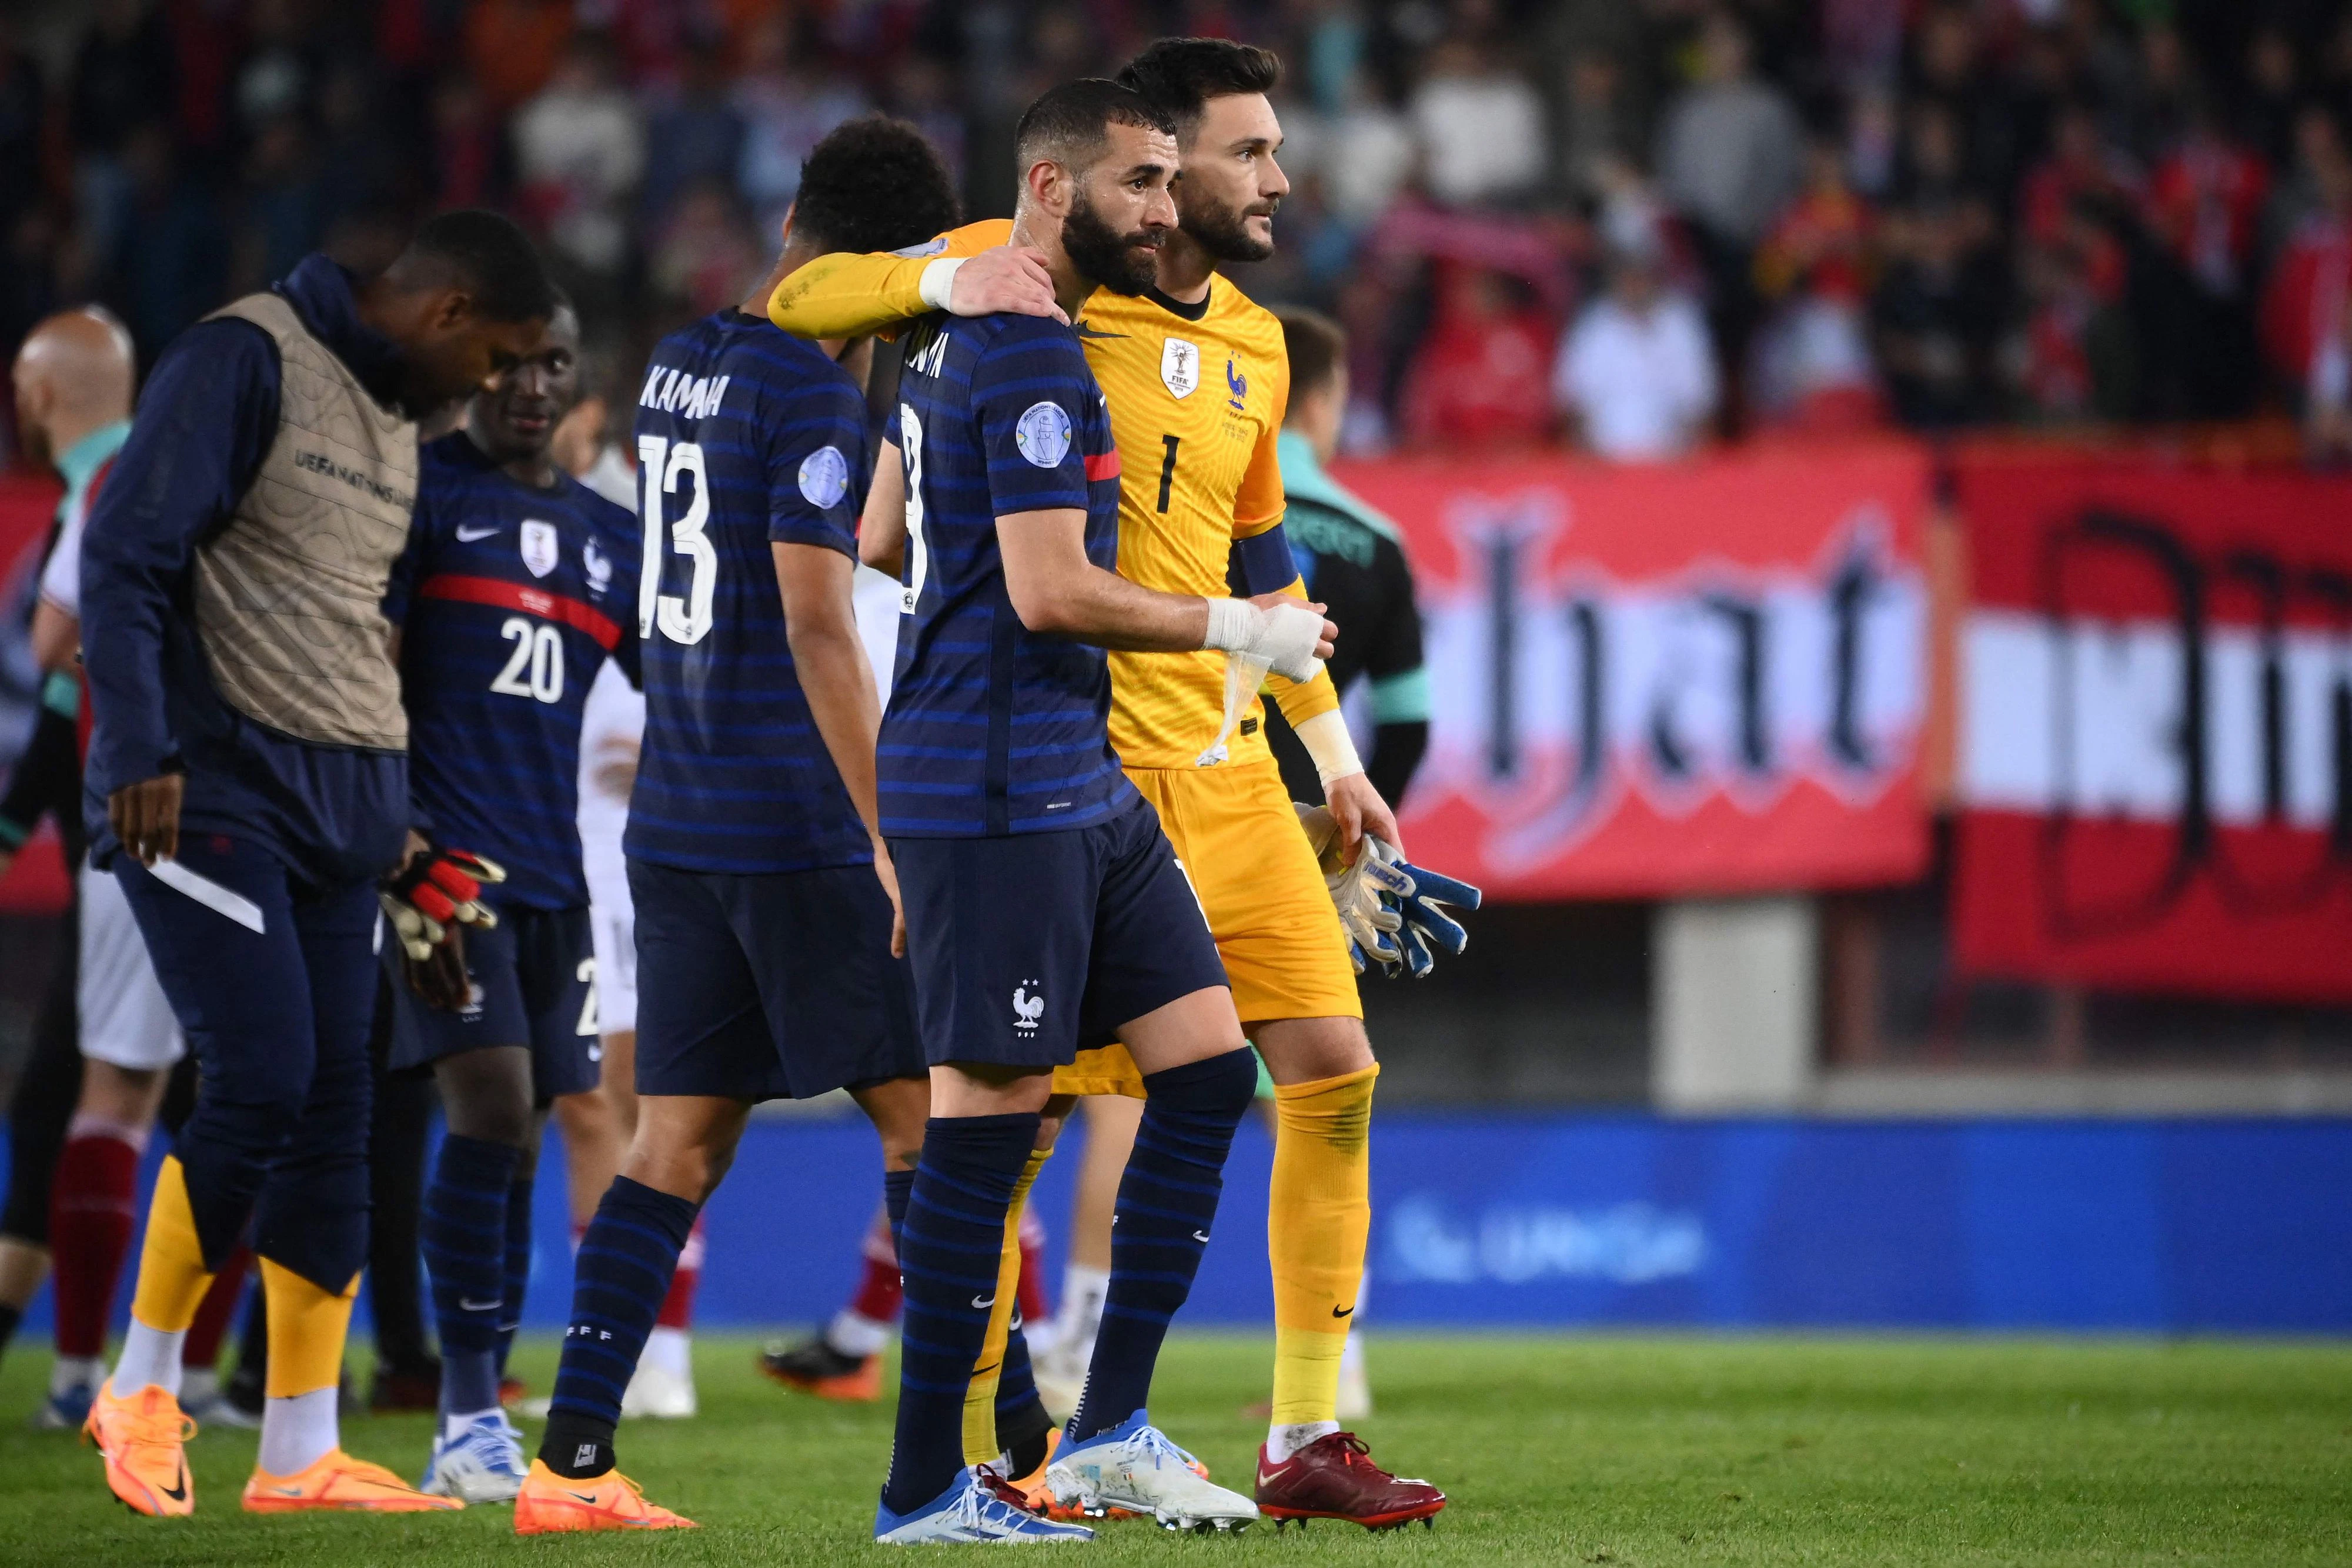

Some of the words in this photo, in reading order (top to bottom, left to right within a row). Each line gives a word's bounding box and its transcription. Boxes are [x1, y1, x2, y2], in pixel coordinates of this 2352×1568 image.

[1172, 375, 1187, 385] FIFA
[1156, 434, 1180, 514] 1
[639, 434, 717, 645] 13
[489, 617, 564, 704] 20
